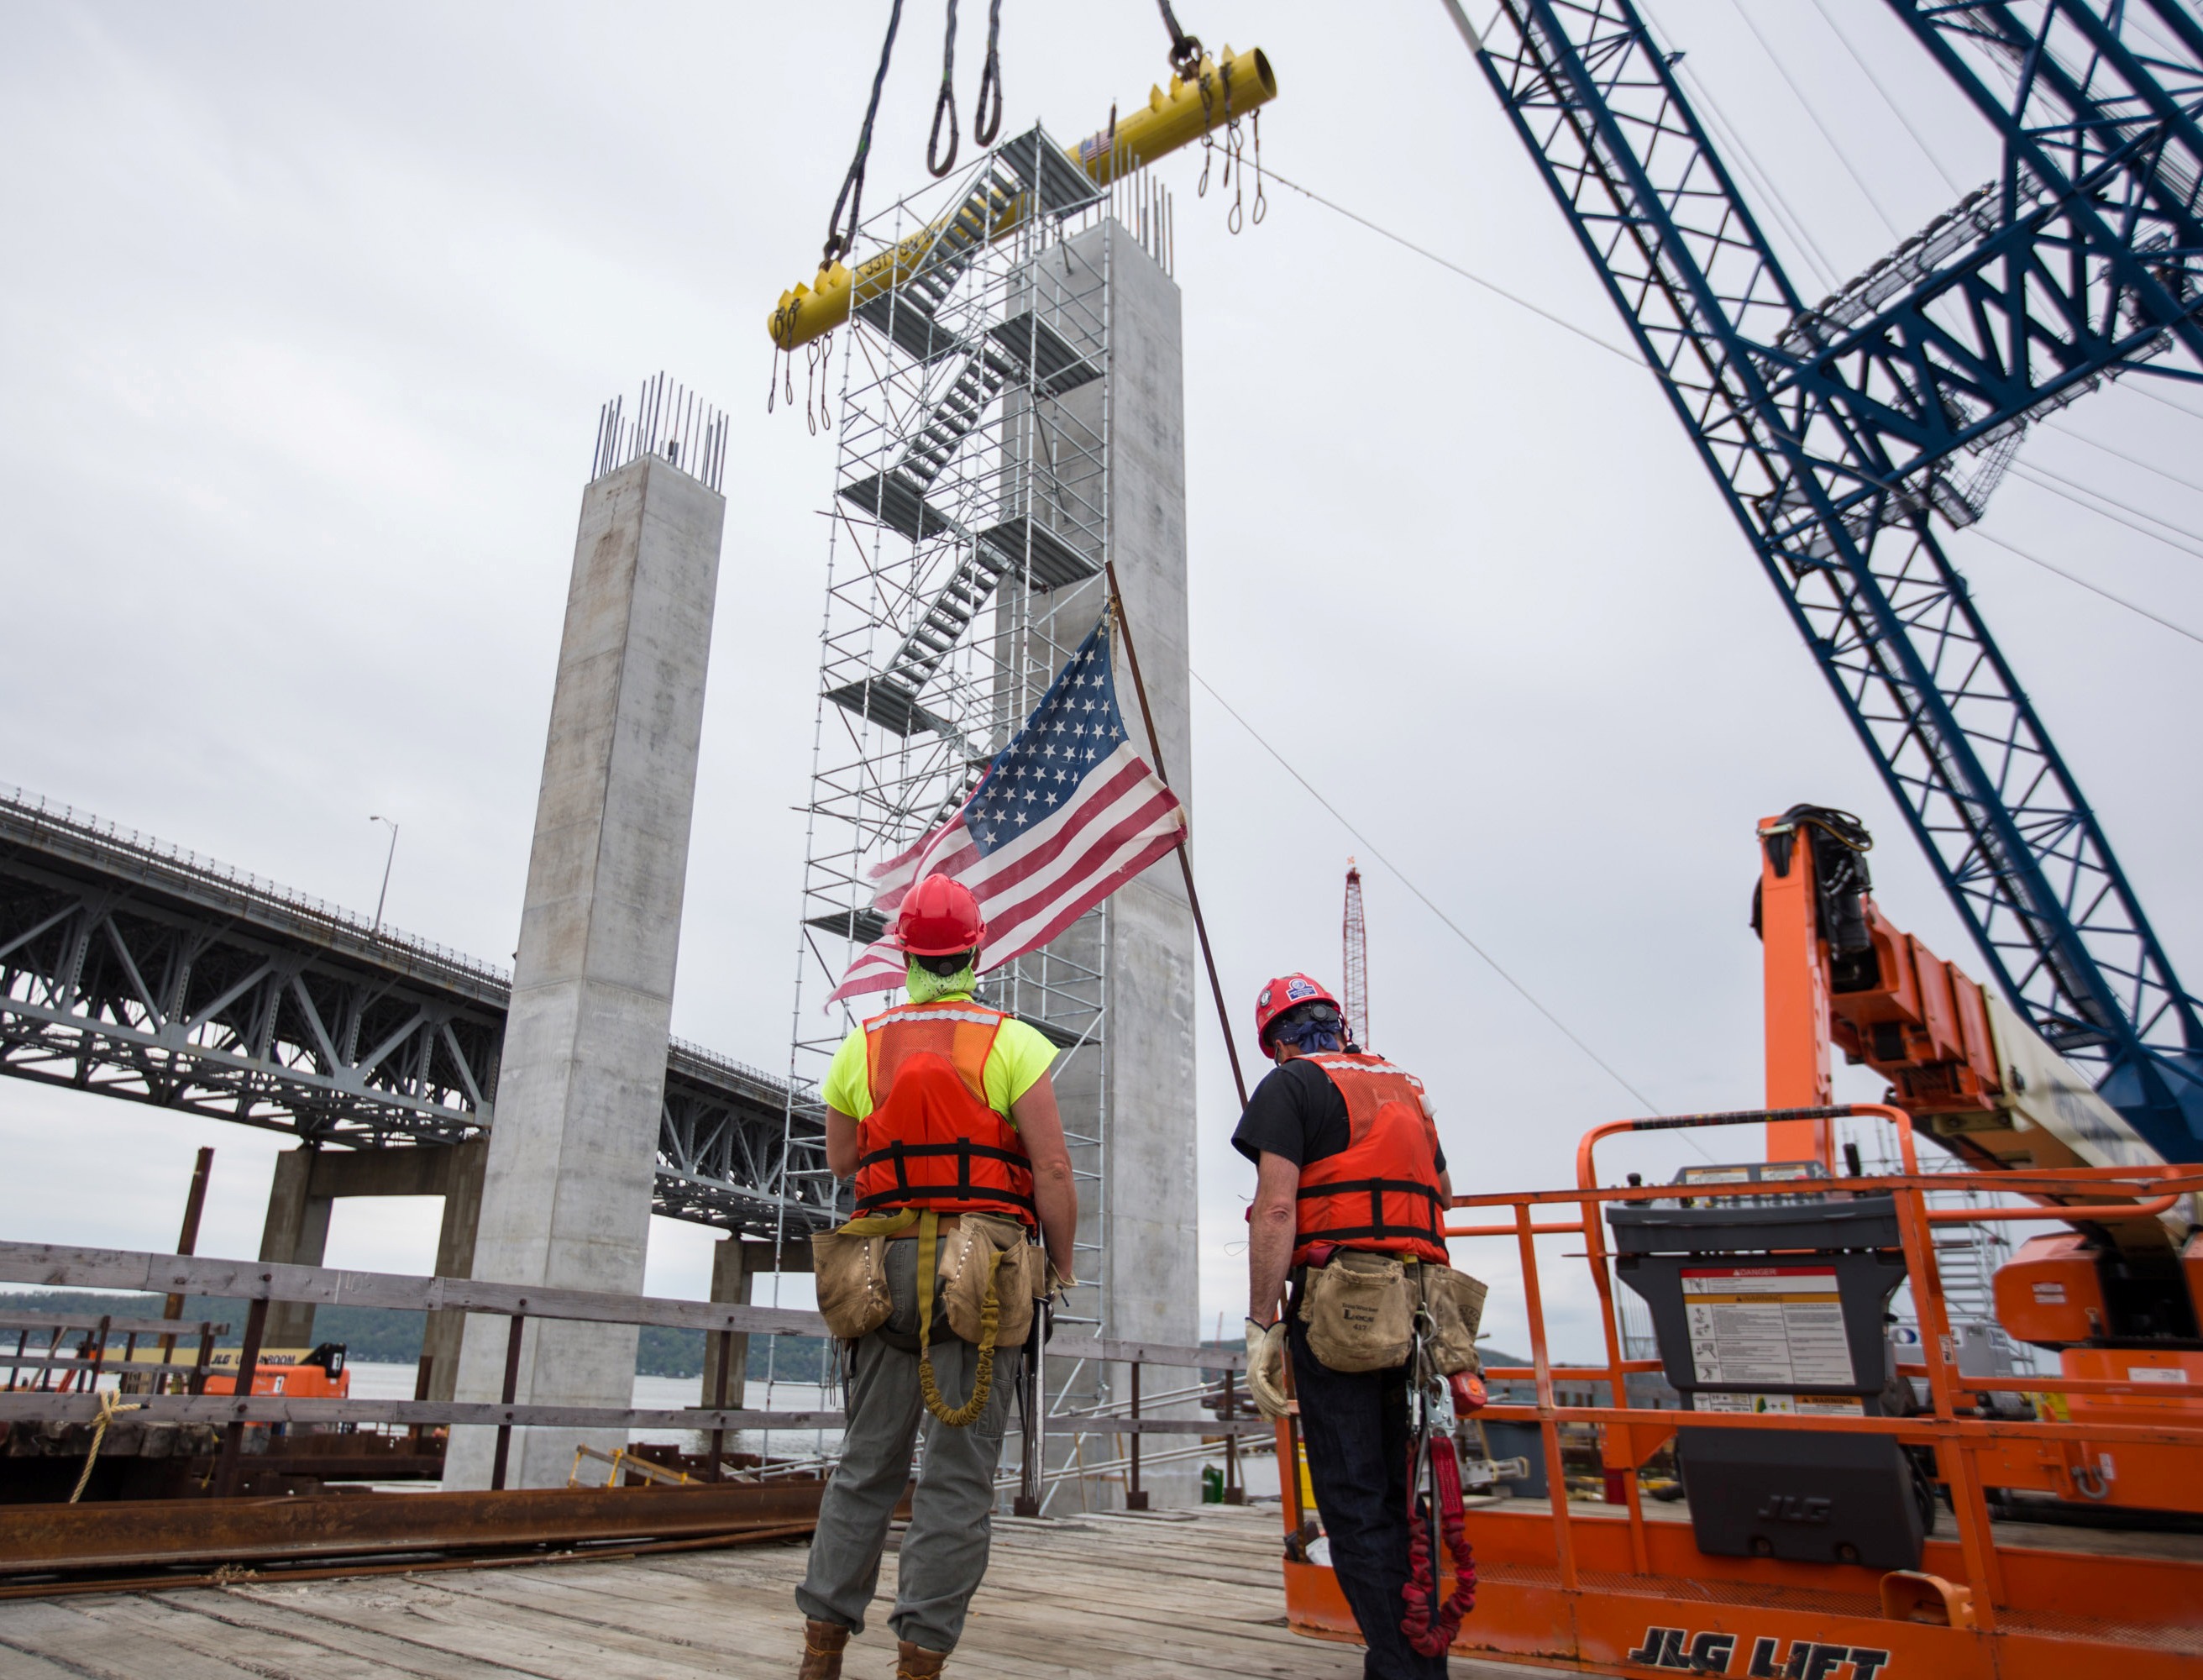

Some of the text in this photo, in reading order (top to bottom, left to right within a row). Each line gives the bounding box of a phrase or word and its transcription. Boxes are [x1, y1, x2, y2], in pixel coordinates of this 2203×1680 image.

[211, 1354, 232, 1364] JLG
[1756, 1495, 1832, 1521] JLG
[1628, 1626, 1891, 1680] JLG LIFT
